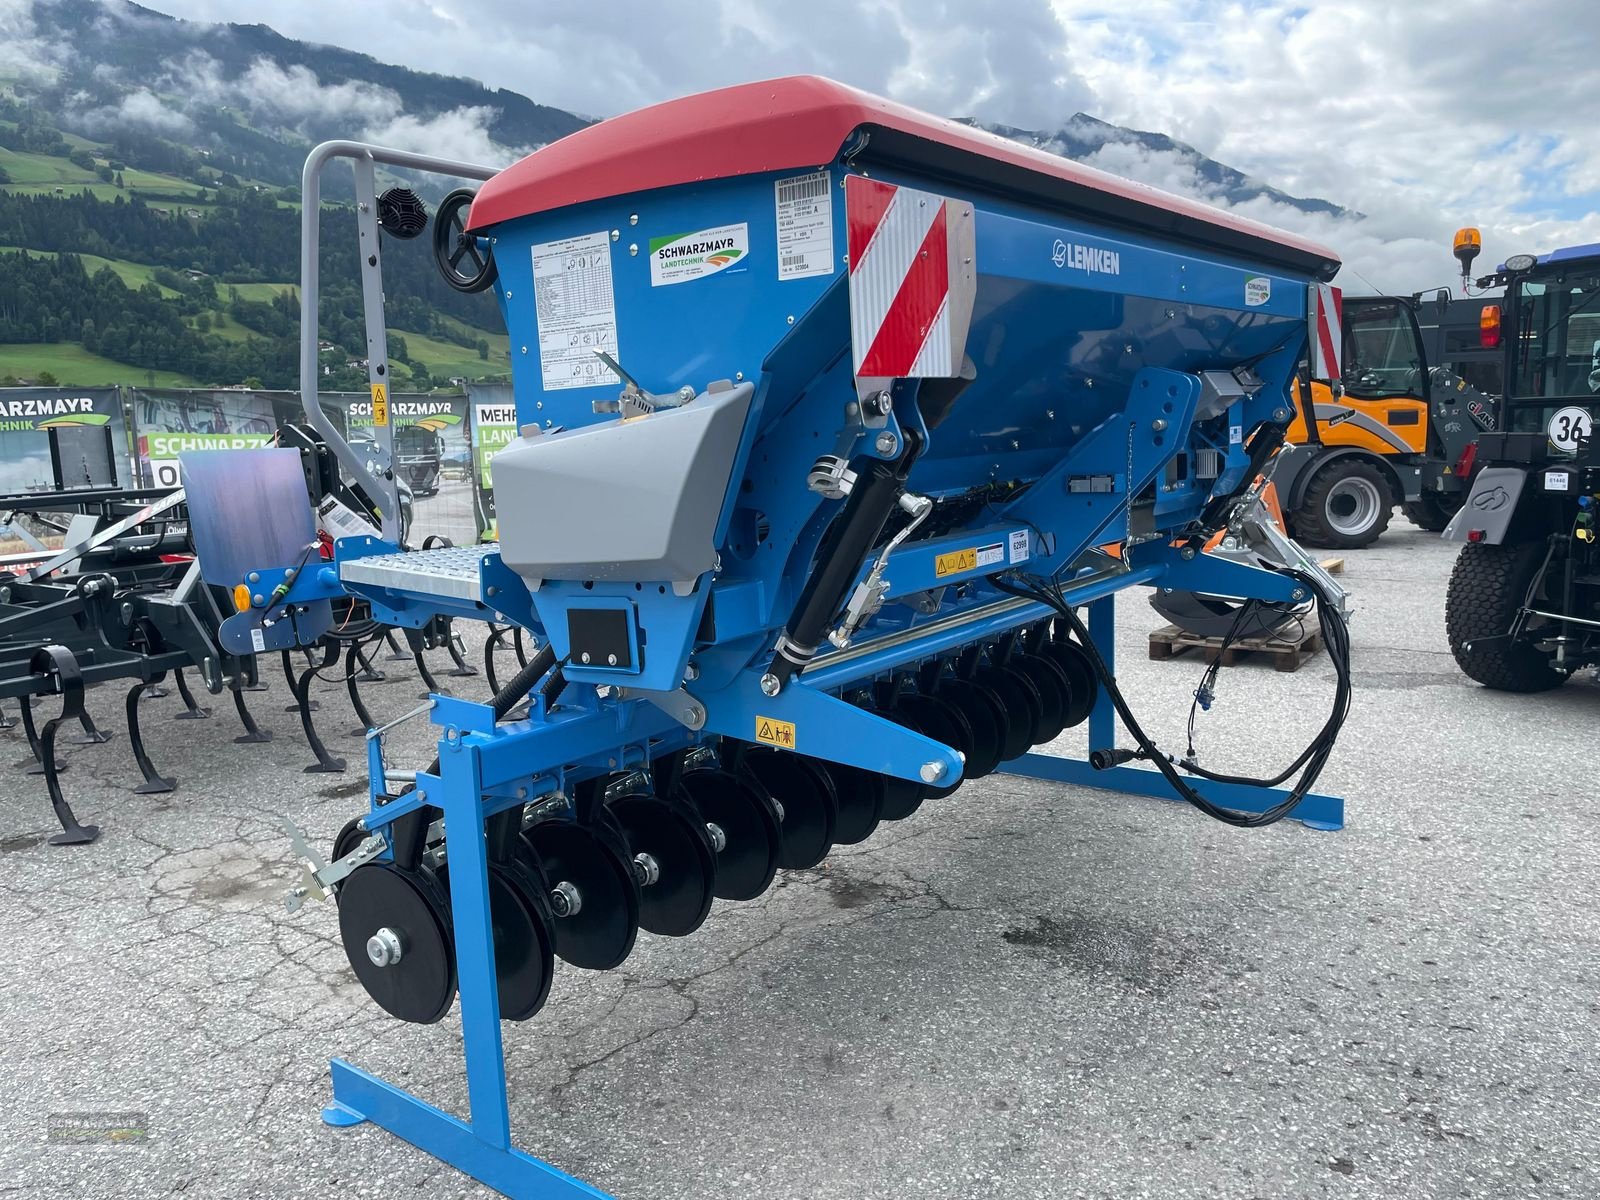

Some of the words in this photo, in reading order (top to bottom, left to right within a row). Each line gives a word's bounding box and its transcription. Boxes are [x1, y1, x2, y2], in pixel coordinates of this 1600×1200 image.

[659, 238, 734, 259] SCHWARZMAYR
[1067, 243, 1120, 276] LEMKEN
[660, 257, 704, 269] LANDTECHNIK
[1557, 416, 1582, 442] 36
